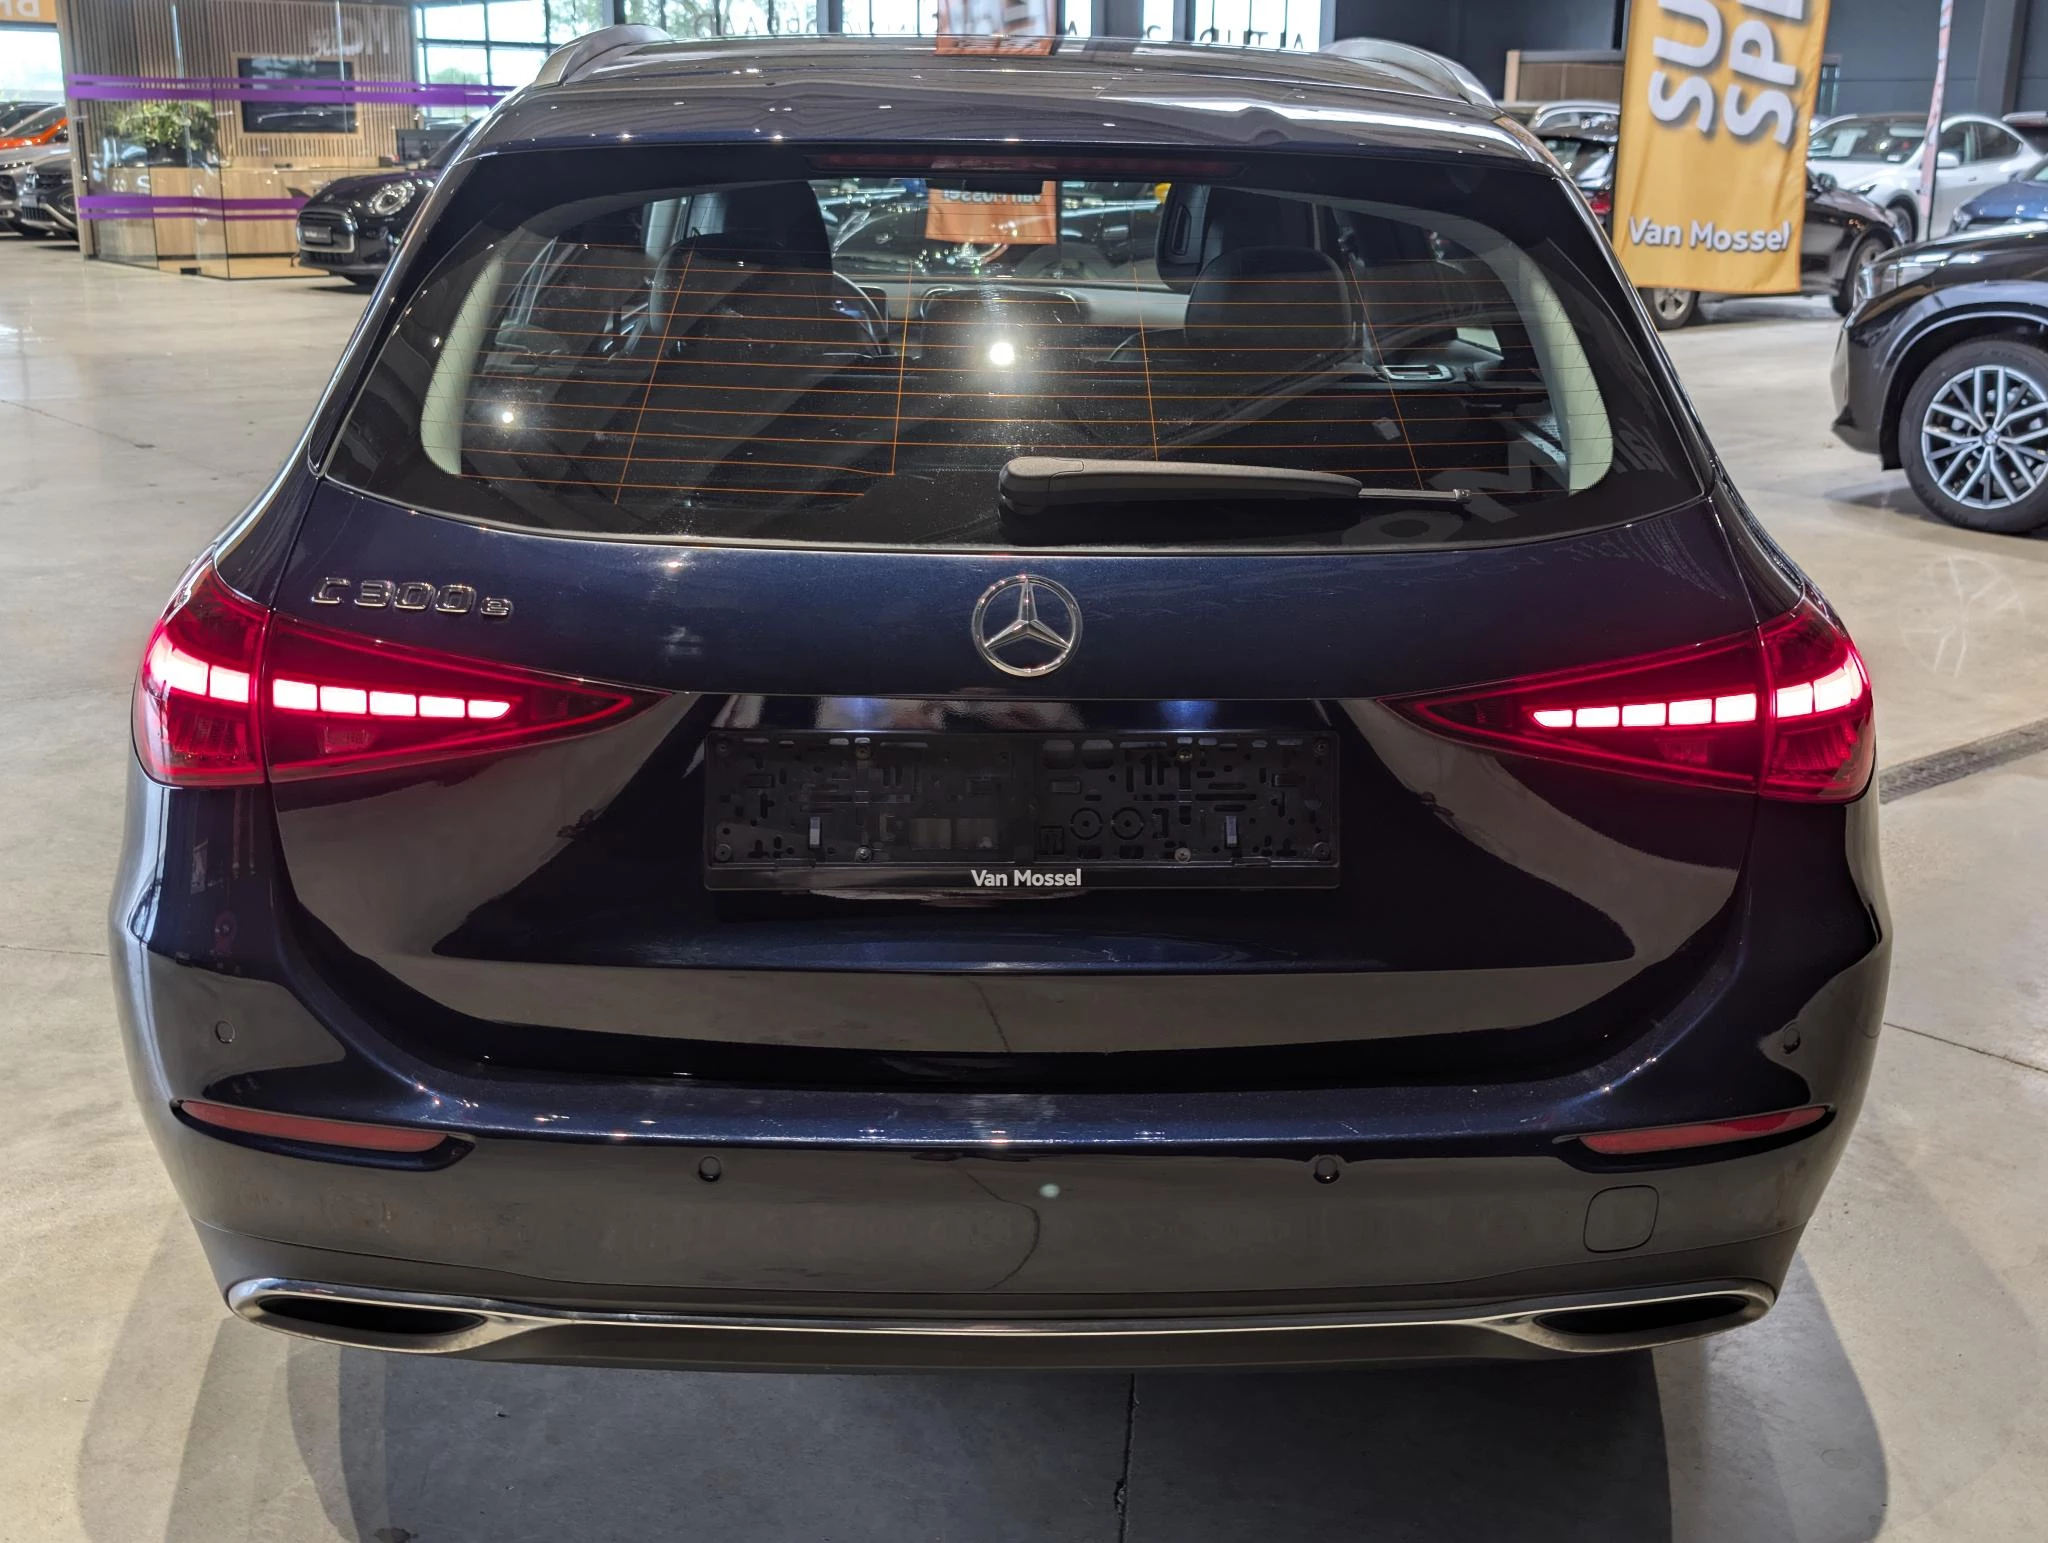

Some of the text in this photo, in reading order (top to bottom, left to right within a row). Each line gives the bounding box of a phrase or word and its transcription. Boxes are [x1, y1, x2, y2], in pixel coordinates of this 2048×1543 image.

[1629, 216, 1791, 252] Van Mossel
[970, 868, 1082, 887] Van Mossel
